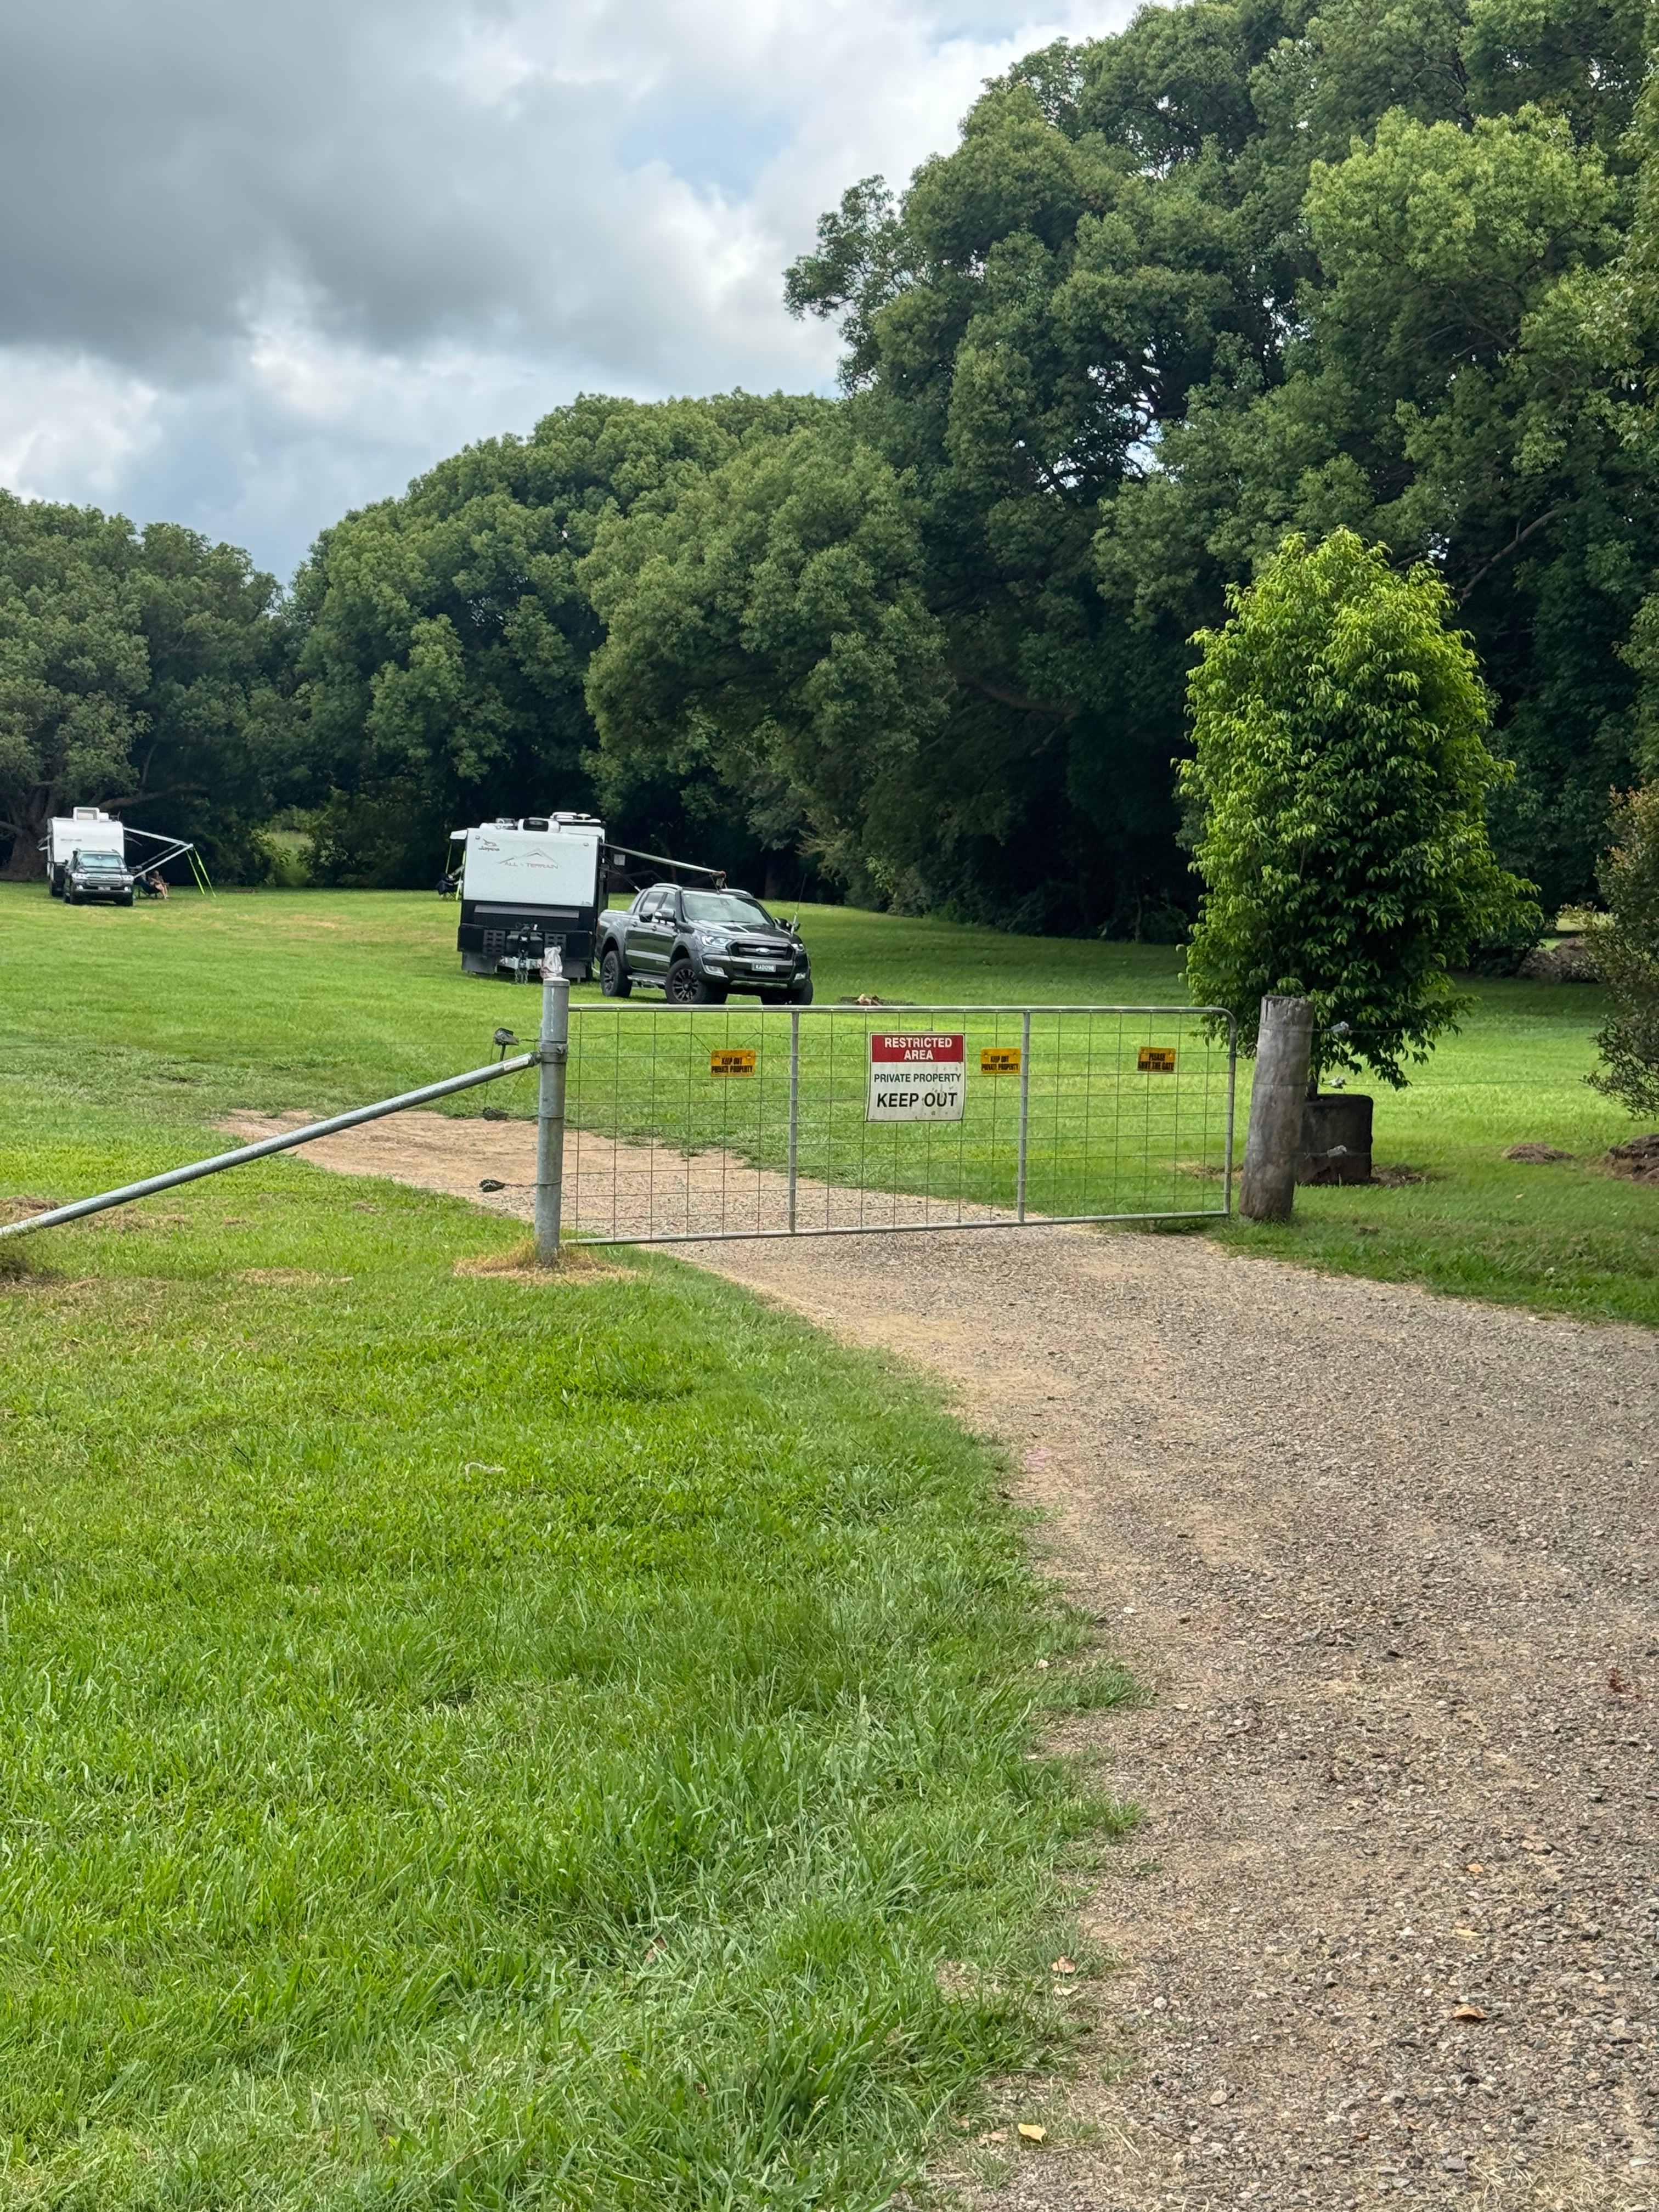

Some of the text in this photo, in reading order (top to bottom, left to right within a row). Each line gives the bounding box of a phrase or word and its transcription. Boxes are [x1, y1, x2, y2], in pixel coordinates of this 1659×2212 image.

[884, 1037, 952, 1048] RESTRICTED
[904, 1050, 934, 1060] AREA
[874, 1074, 961, 1082] PRIVATE PROPERTY
[877, 1092, 957, 1108] KEEP OUT
